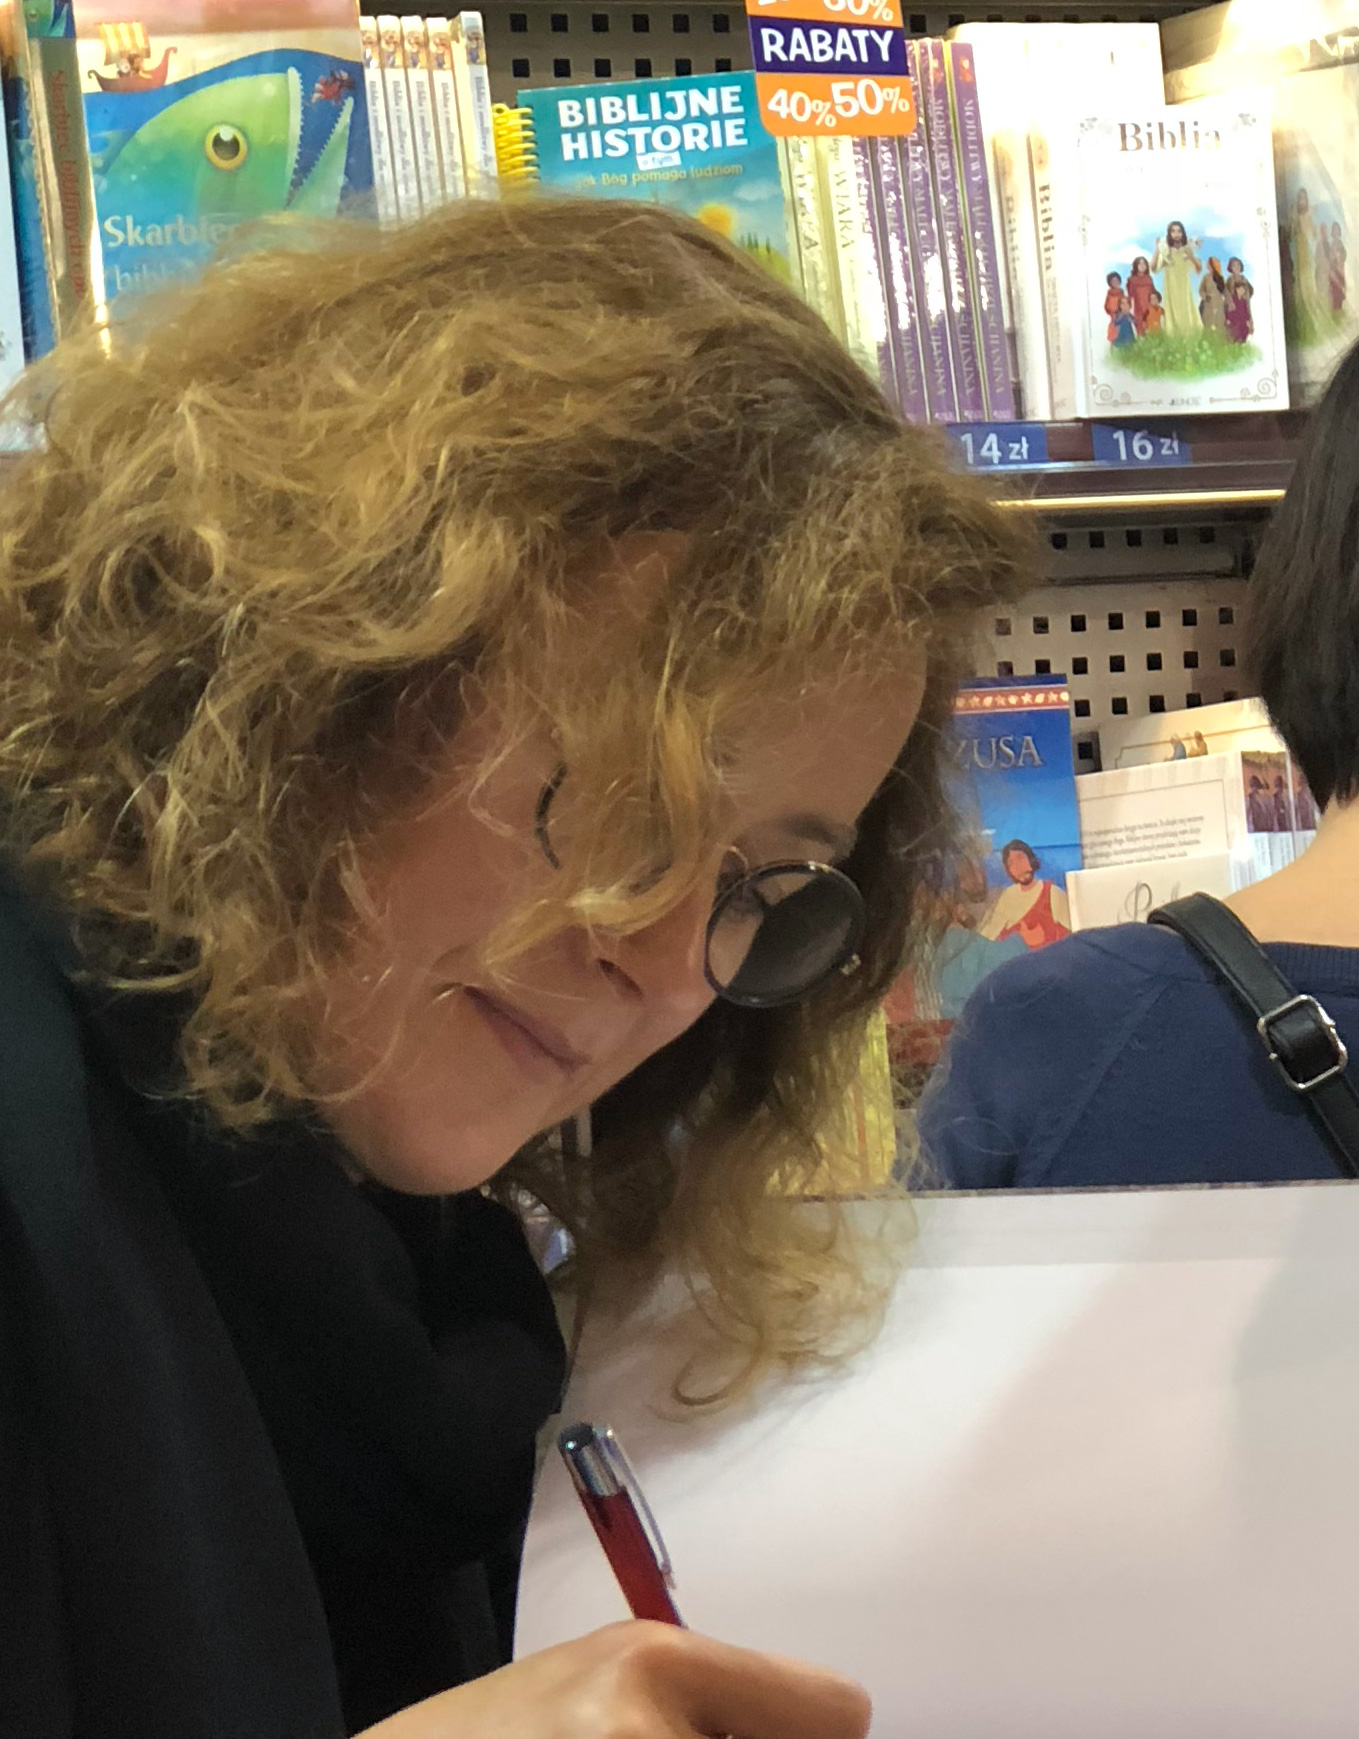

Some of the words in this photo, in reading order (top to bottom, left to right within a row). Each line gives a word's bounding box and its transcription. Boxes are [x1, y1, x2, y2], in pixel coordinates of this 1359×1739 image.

[760, 27, 894, 63] RABATY
[558, 85, 745, 128] BIBLIJNE
[768, 88, 837, 127] 40%
[831, 79, 910, 119] 50%
[561, 119, 748, 160] HISTORIE
[1118, 121, 1221, 151] Biblia
[632, 167, 688, 184] pomaga
[960, 432, 1002, 464] 14
[1008, 437, 1029, 459] zł
[1113, 430, 1154, 461] 16
[1161, 432, 1180, 455] zł
